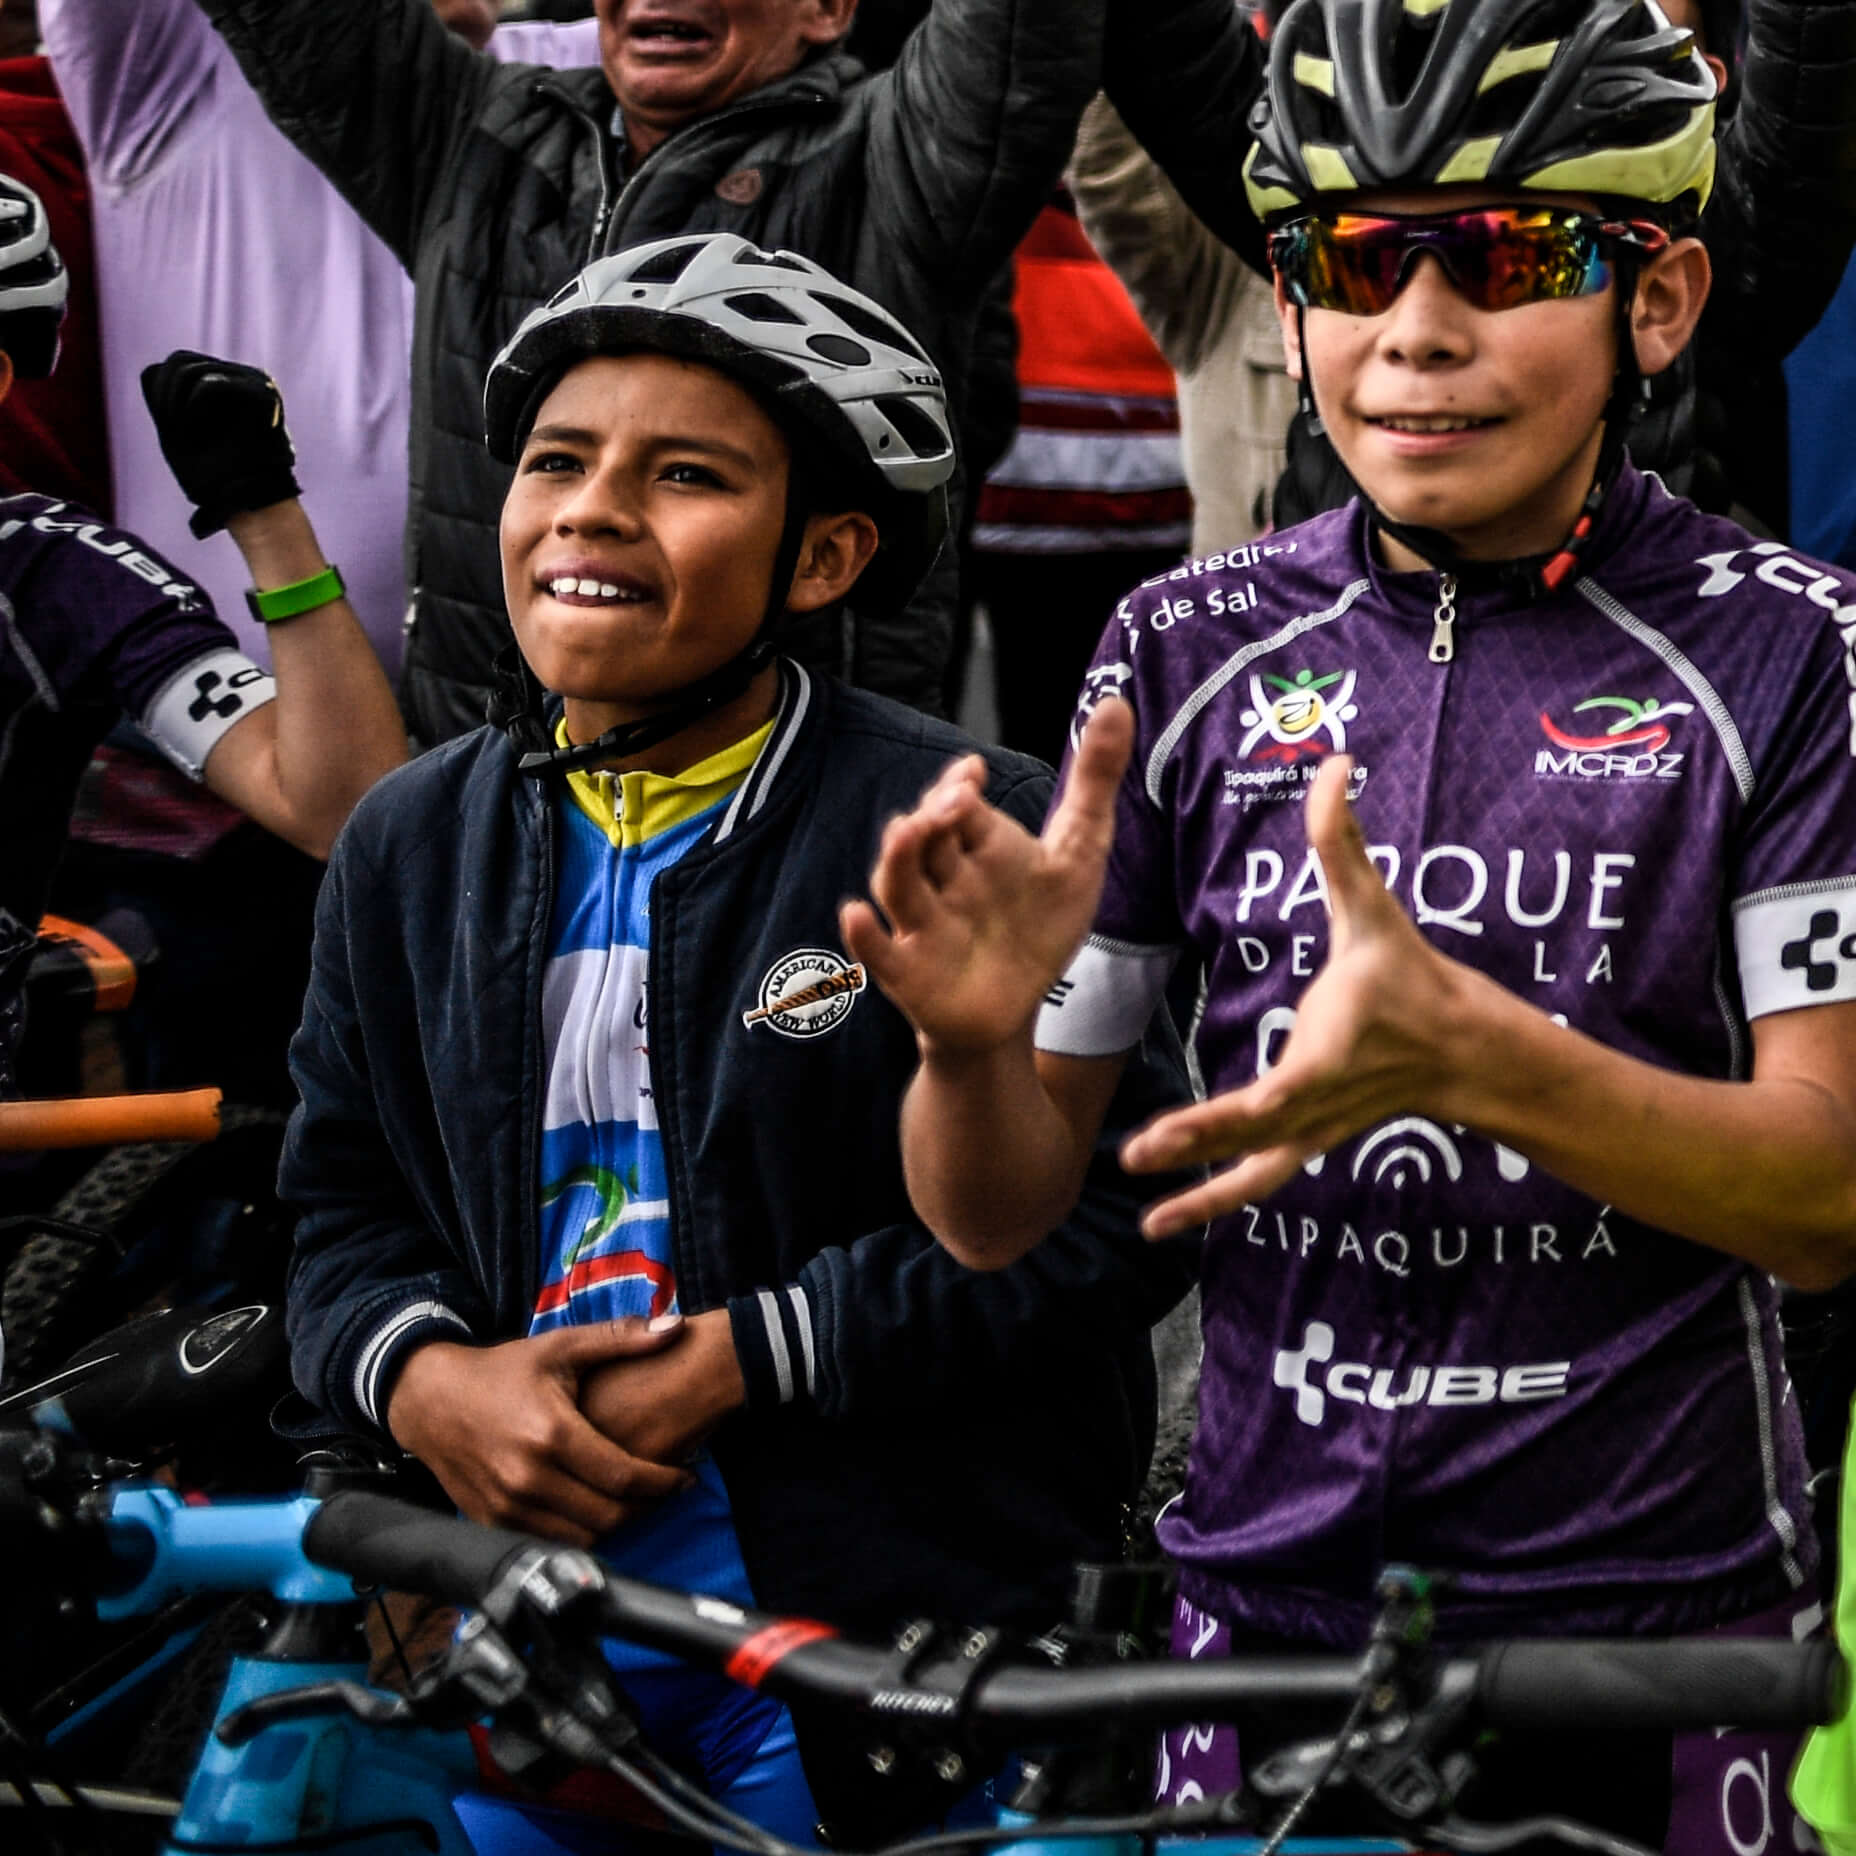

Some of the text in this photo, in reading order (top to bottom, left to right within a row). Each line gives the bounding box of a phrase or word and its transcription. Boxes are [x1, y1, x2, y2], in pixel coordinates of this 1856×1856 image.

[1150, 598, 1195, 632] de
[1206, 582, 1259, 616] Sal
[769, 957, 838, 998] AMERICAN
[1237, 934, 1614, 985] DE LA
[807, 994, 847, 1030] WORLD
[1242, 1204, 1618, 1277] ZIPAQUIRÁ
[1325, 1360, 1572, 1412] CUBE
